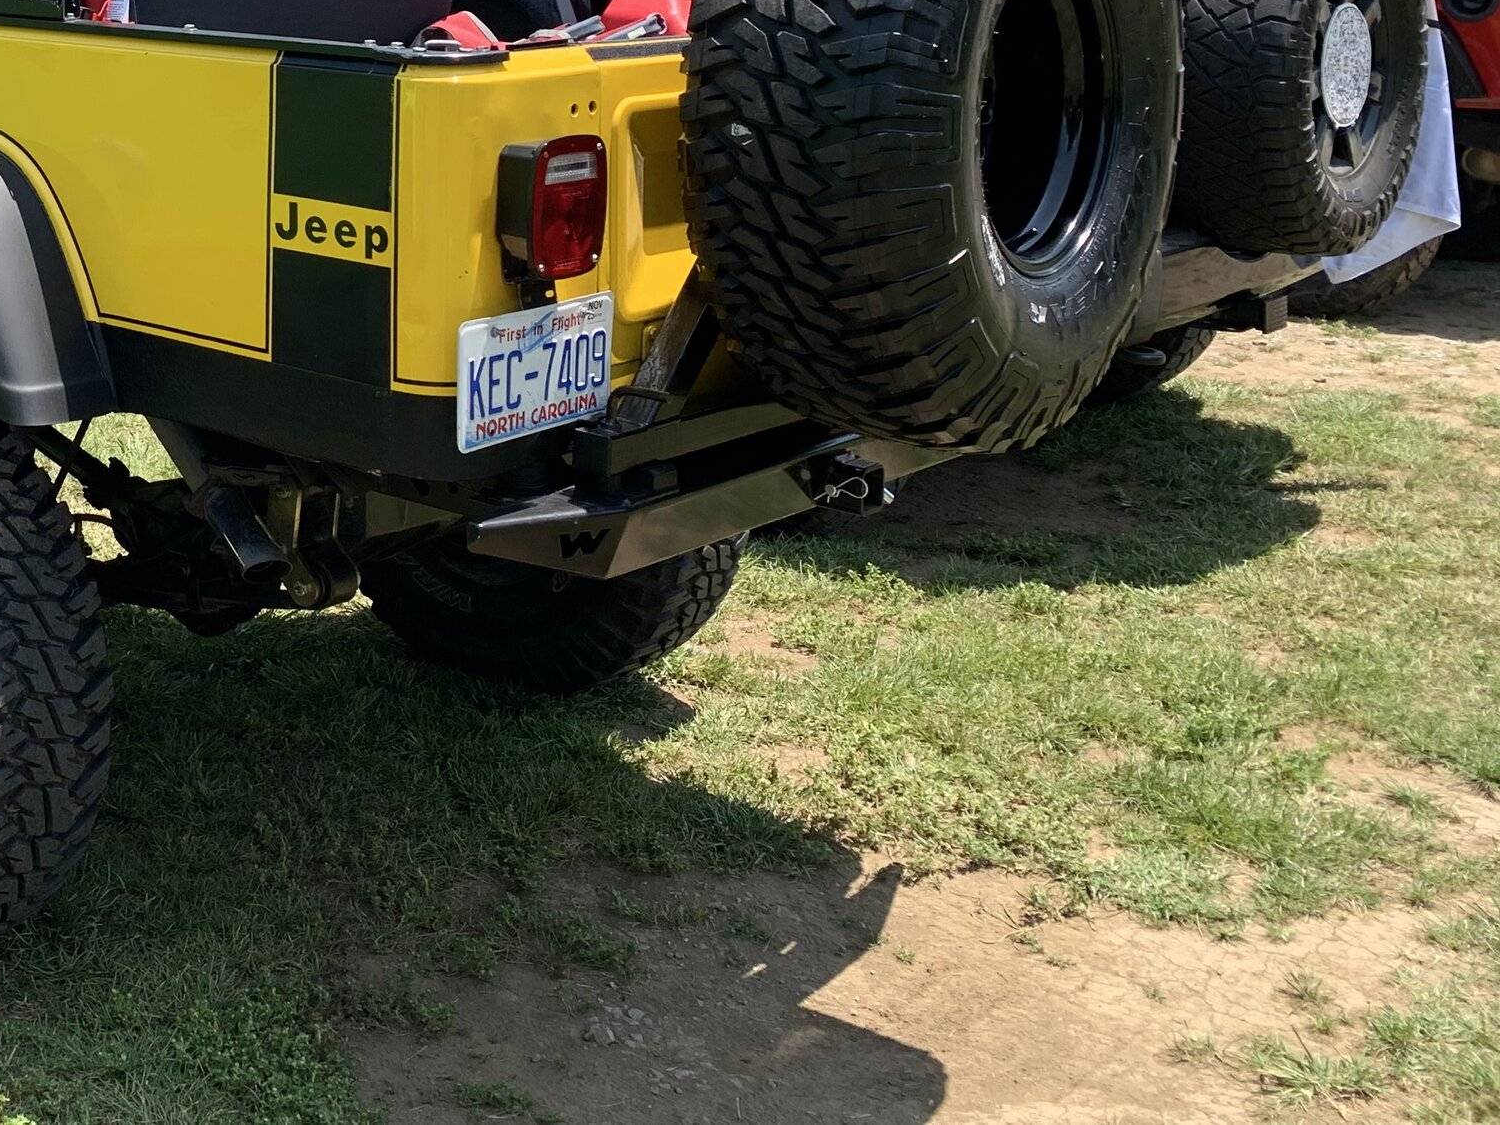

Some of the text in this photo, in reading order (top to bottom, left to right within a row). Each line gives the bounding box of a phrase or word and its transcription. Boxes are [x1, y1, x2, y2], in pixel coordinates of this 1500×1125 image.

[275, 201, 389, 259] Jeep
[499, 315, 581, 343] First in Flight
[469, 329, 607, 421] KEC-7409
[476, 392, 598, 440] NORTH CAROLINA
